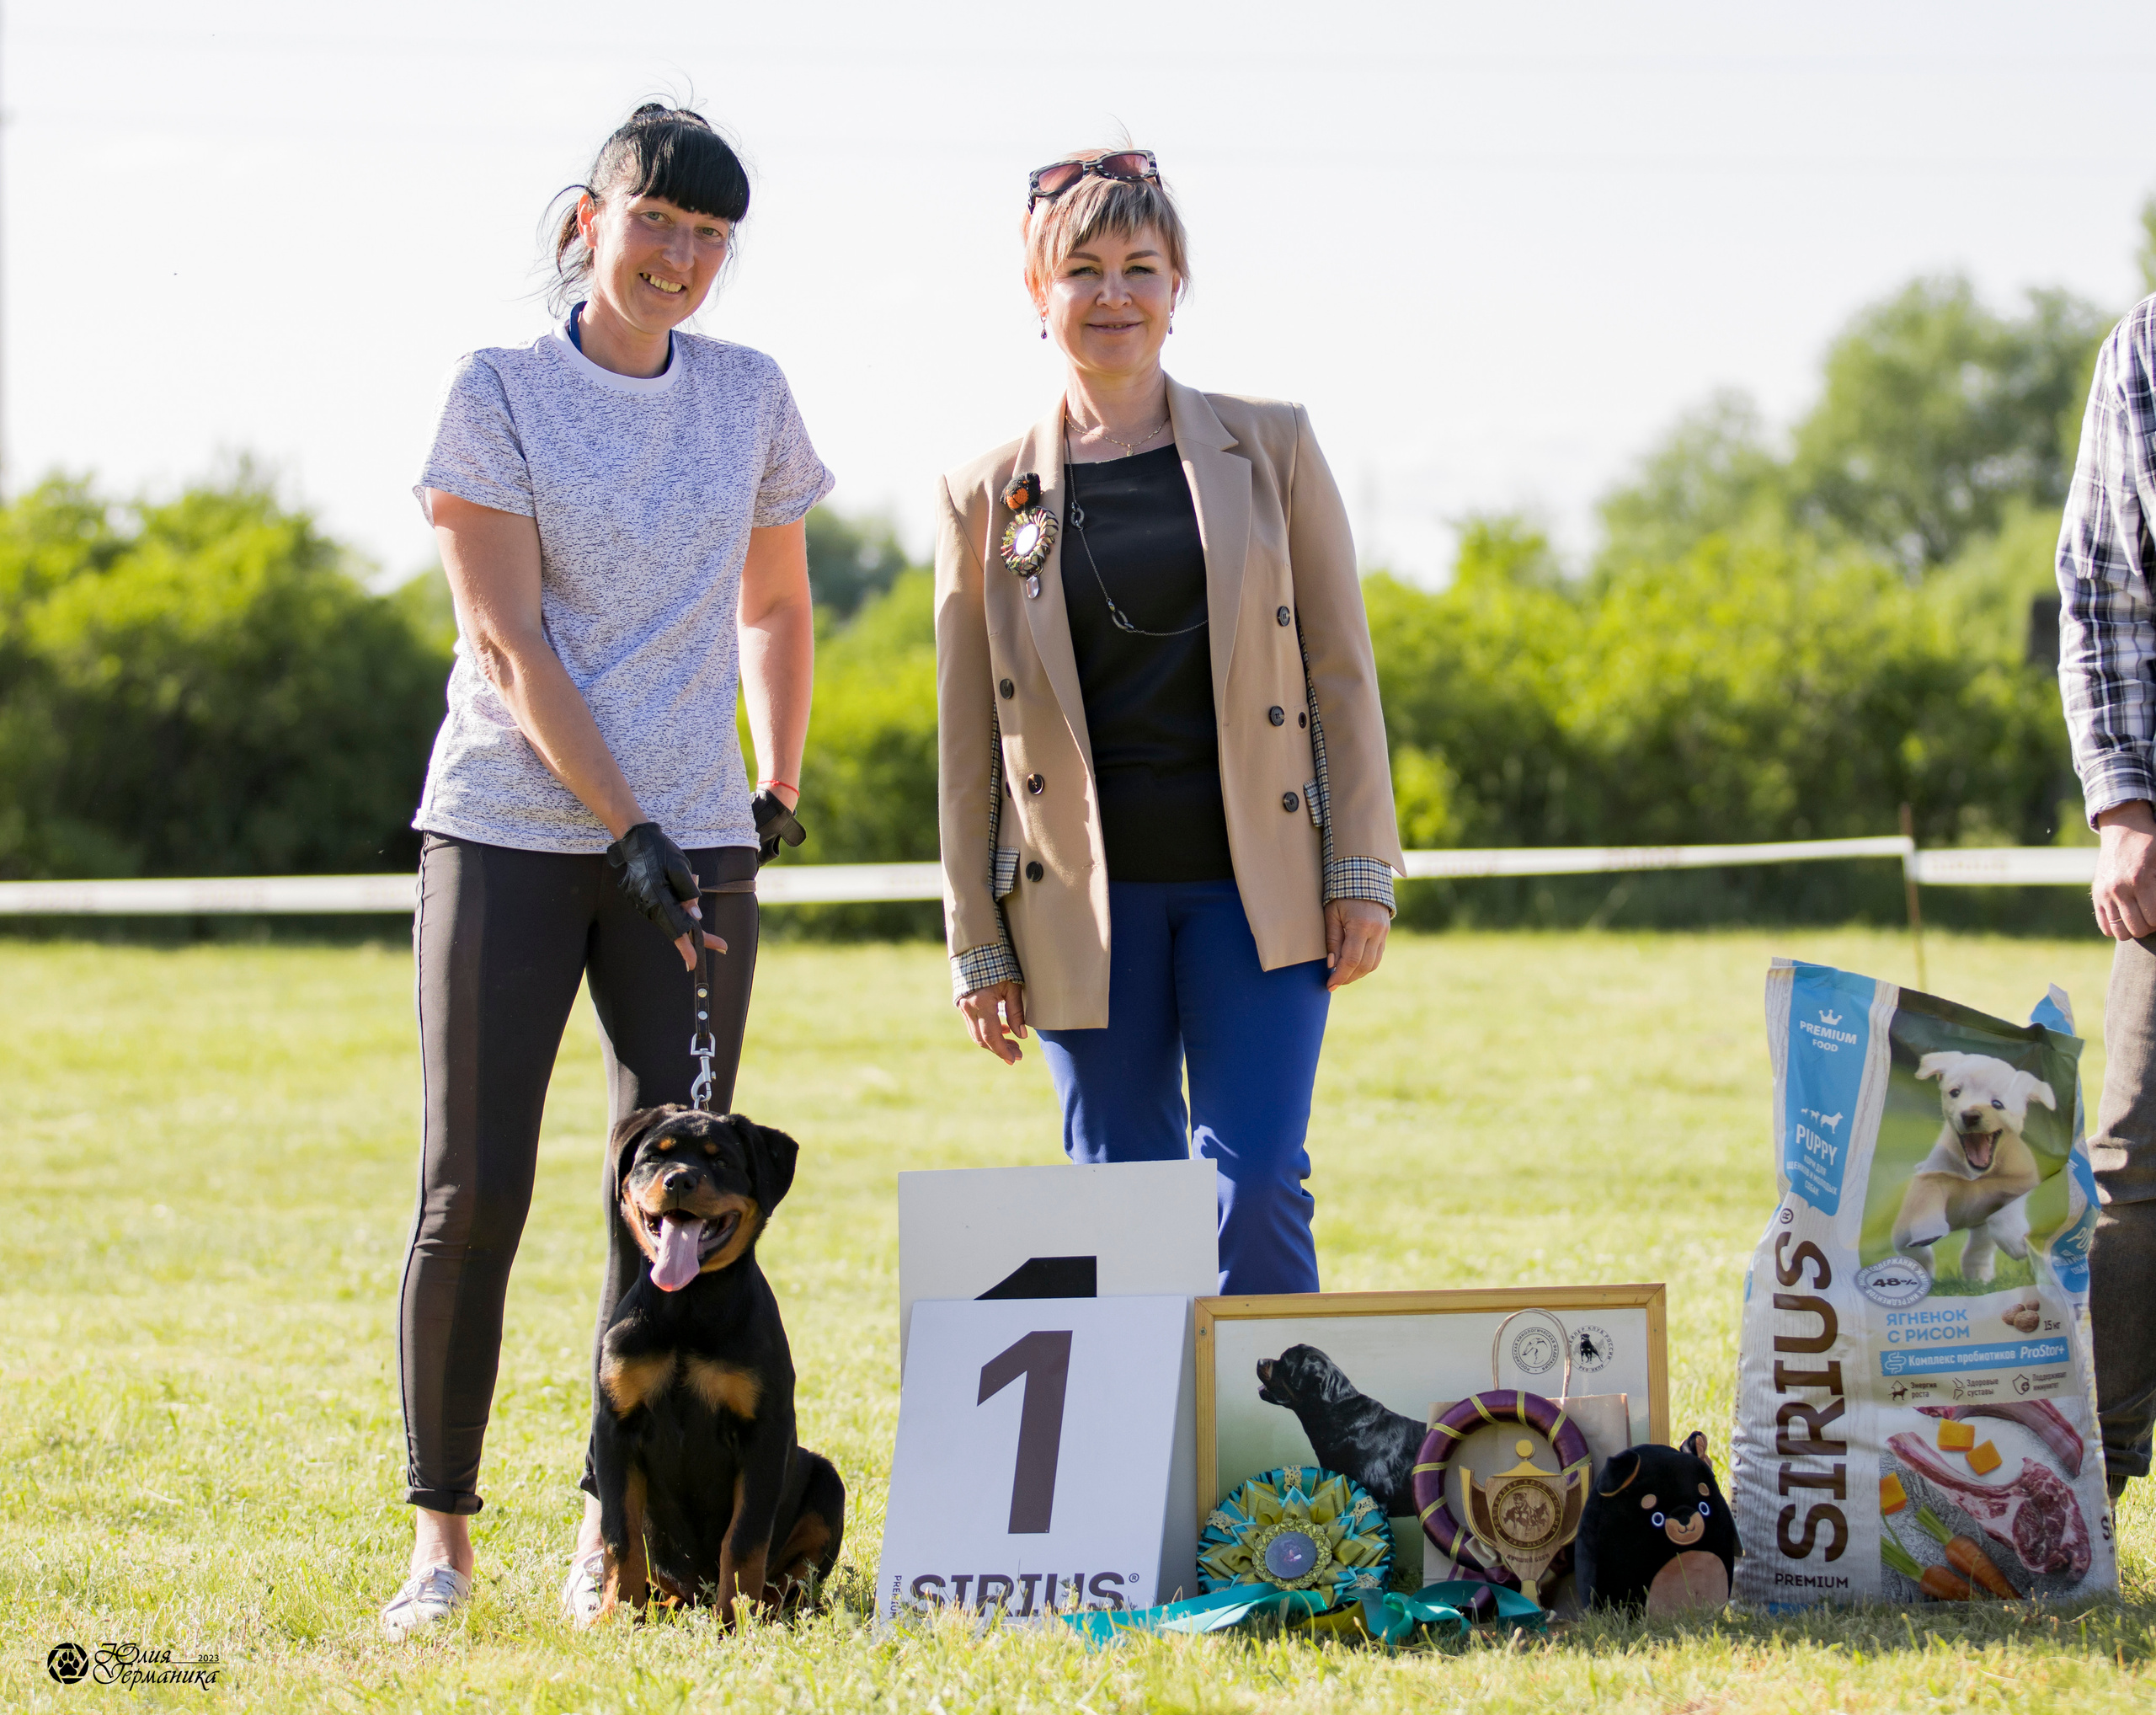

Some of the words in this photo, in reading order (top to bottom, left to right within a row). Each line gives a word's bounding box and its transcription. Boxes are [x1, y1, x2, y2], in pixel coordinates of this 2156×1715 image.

[1800, 1020, 1857, 1044] PREMIUM
[1812, 1039, 1838, 1052] FOOD
[1796, 1123, 1838, 1166] PUPPY
[1870, 1258, 1918, 1272] СОДЕРЖАНИЕ
[1872, 1278, 1918, 1287] 48%
[1886, 1309, 1968, 1326] ЯГНЕНОК
[2044, 1320, 2052, 1331] 15
[1517, 1328, 1556, 1344] КИНОЛОГИЧЕСКАЯ
[1887, 1330, 1900, 1344] С
[1905, 1326, 1970, 1342] РИСОМ
[1513, 1343, 1530, 1371] РОССИЙСКАЯ
[1908, 1354, 1955, 1367] Комплекс
[1957, 1349, 2015, 1365] пробиотиков
[1967, 1378, 1999, 1387] Здоровые
[1967, 1388, 1994, 1397] суставы
[977, 1329, 1073, 1535] 1
[1774, 1573, 1849, 1589] PREMIUM
